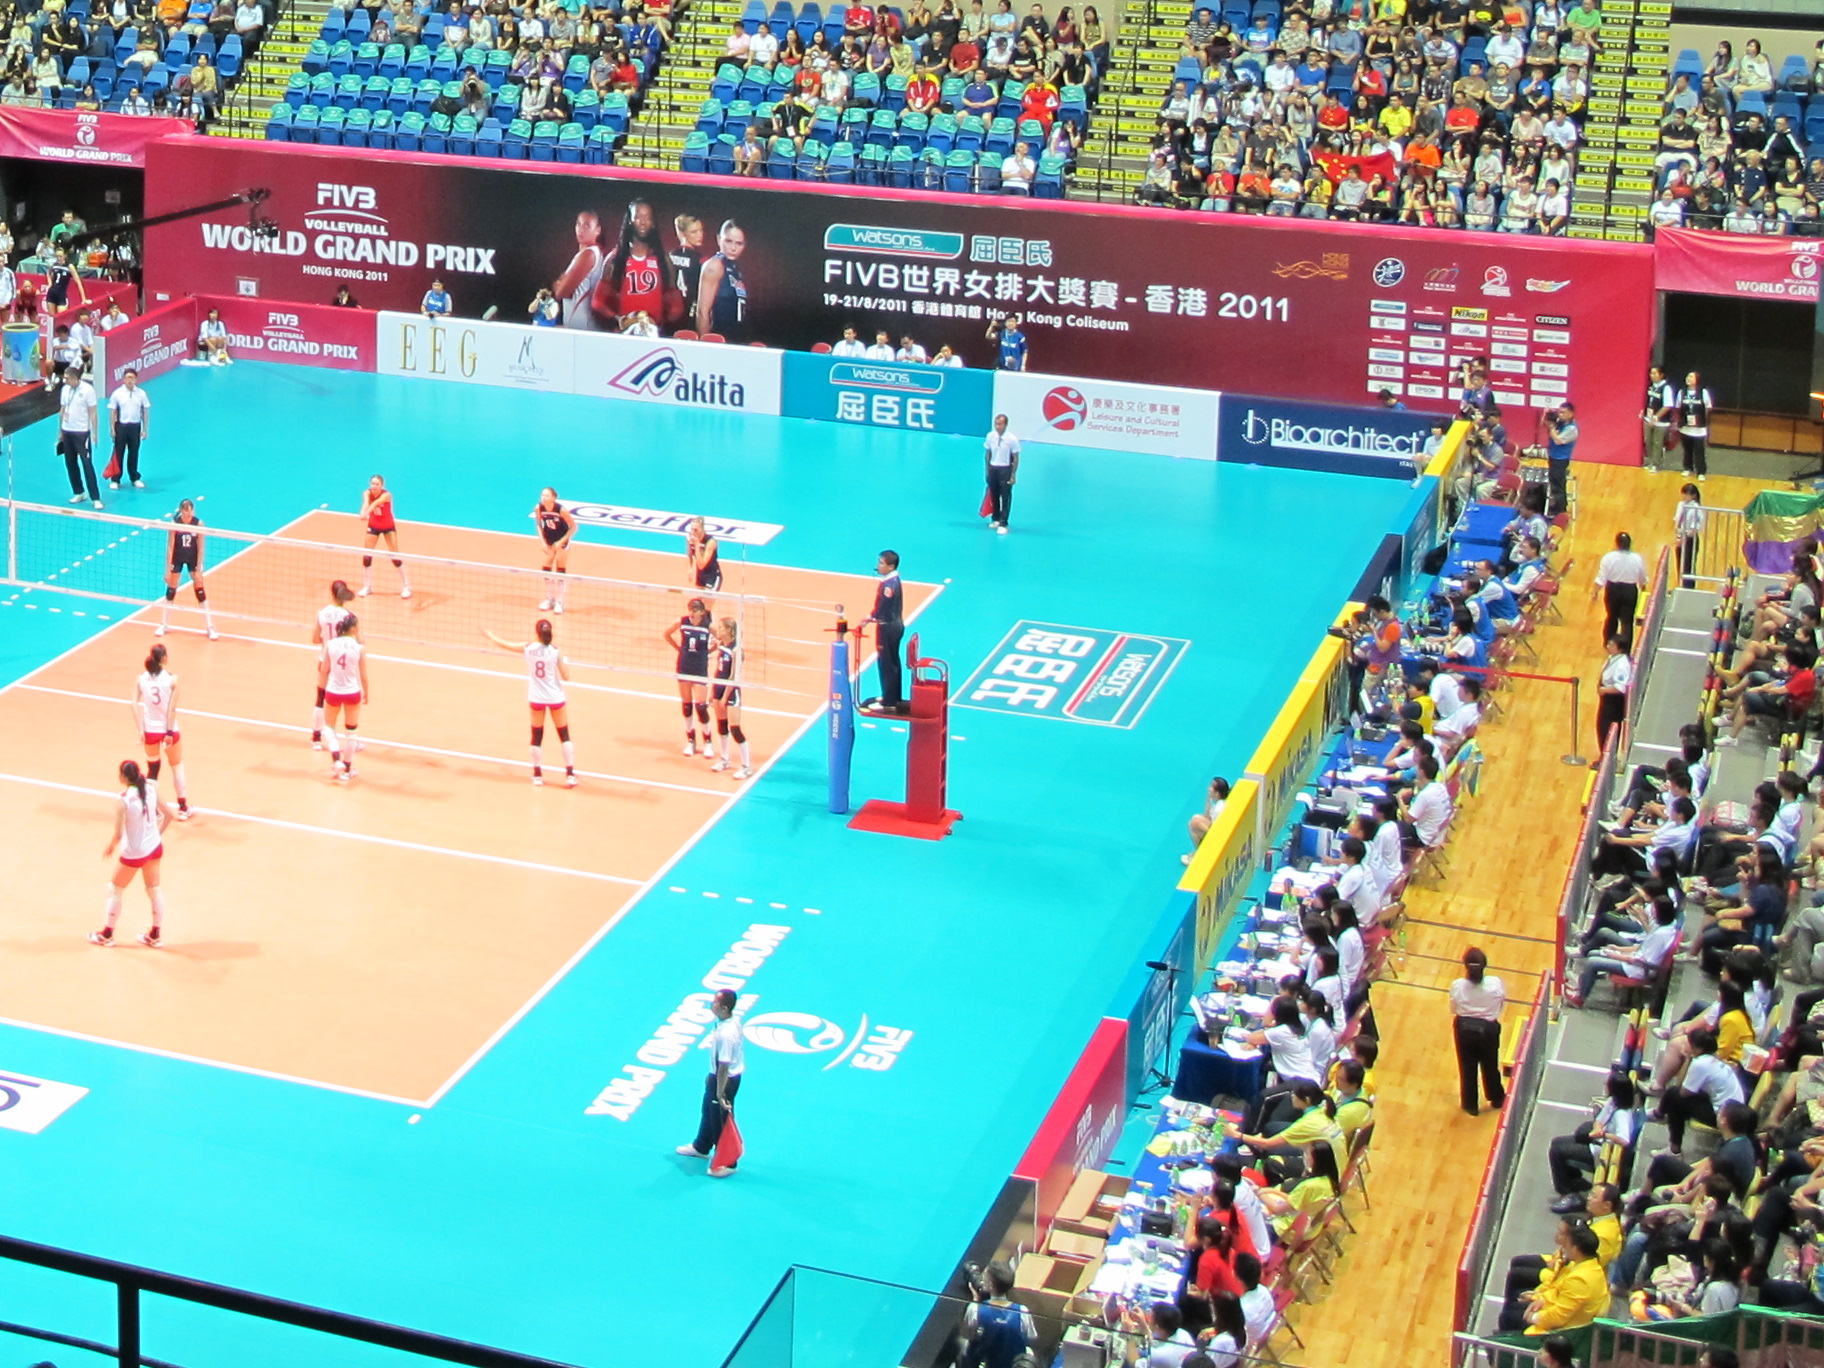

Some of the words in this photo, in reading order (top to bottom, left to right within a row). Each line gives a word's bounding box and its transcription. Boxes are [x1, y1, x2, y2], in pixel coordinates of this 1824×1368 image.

[39, 146, 74, 159] WORLD
[76, 148, 109, 161] GRAND
[110, 152, 134, 164] PRIX
[315, 182, 378, 209] FIVB
[304, 218, 389, 236] VOLLEYBALL
[201, 222, 308, 256] WORLD
[314, 233, 419, 267] GRAND
[425, 243, 496, 274] PRIX
[969, 234, 1053, 267] 屈臣氏
[1791, 241, 1820, 252] FIVB
[302, 264, 333, 277] HONG
[334, 266, 364, 280] KONG
[365, 268, 389, 282] 2011
[625, 269, 658, 296] 19
[1735, 279, 1785, 294] WORLD
[267, 311, 300, 327] FIVB
[823, 292, 908, 313] 19-21/8/2011
[911, 299, 982, 320] 香港體育館
[1026, 309, 1062, 328] Kong
[1066, 314, 1130, 332] Coliseum
[1218, 291, 1291, 323] 2011
[1454, 308, 1486, 320] Nikon
[143, 324, 160, 341] FIVB
[143, 346, 170, 373] GRAND
[170, 337, 188, 360] PRIX
[226, 333, 264, 350] ORLD
[267, 338, 320, 356] GRAND
[323, 343, 359, 360] PRIX
[674, 372, 746, 408] akita
[835, 389, 935, 429] 屈臣氏
[1091, 411, 1124, 424] Leisure
[1125, 414, 1141, 424] and
[1142, 415, 1181, 427] Cultural
[1087, 421, 1124, 434] Services
[1125, 425, 1180, 438] Department
[1270, 418, 1420, 455] Bioarchitect
[569, 505, 747, 536] Gerflor
[180, 533, 193, 548] 12
[336, 653, 348, 671] 4
[534, 660, 547, 680] 8
[150, 685, 162, 706] 3
[701, 923, 792, 992] WORLD
[635, 991, 717, 1067] GRAND
[849, 1024, 916, 1072] FIVB
[583, 1063, 667, 1123] PRIX
